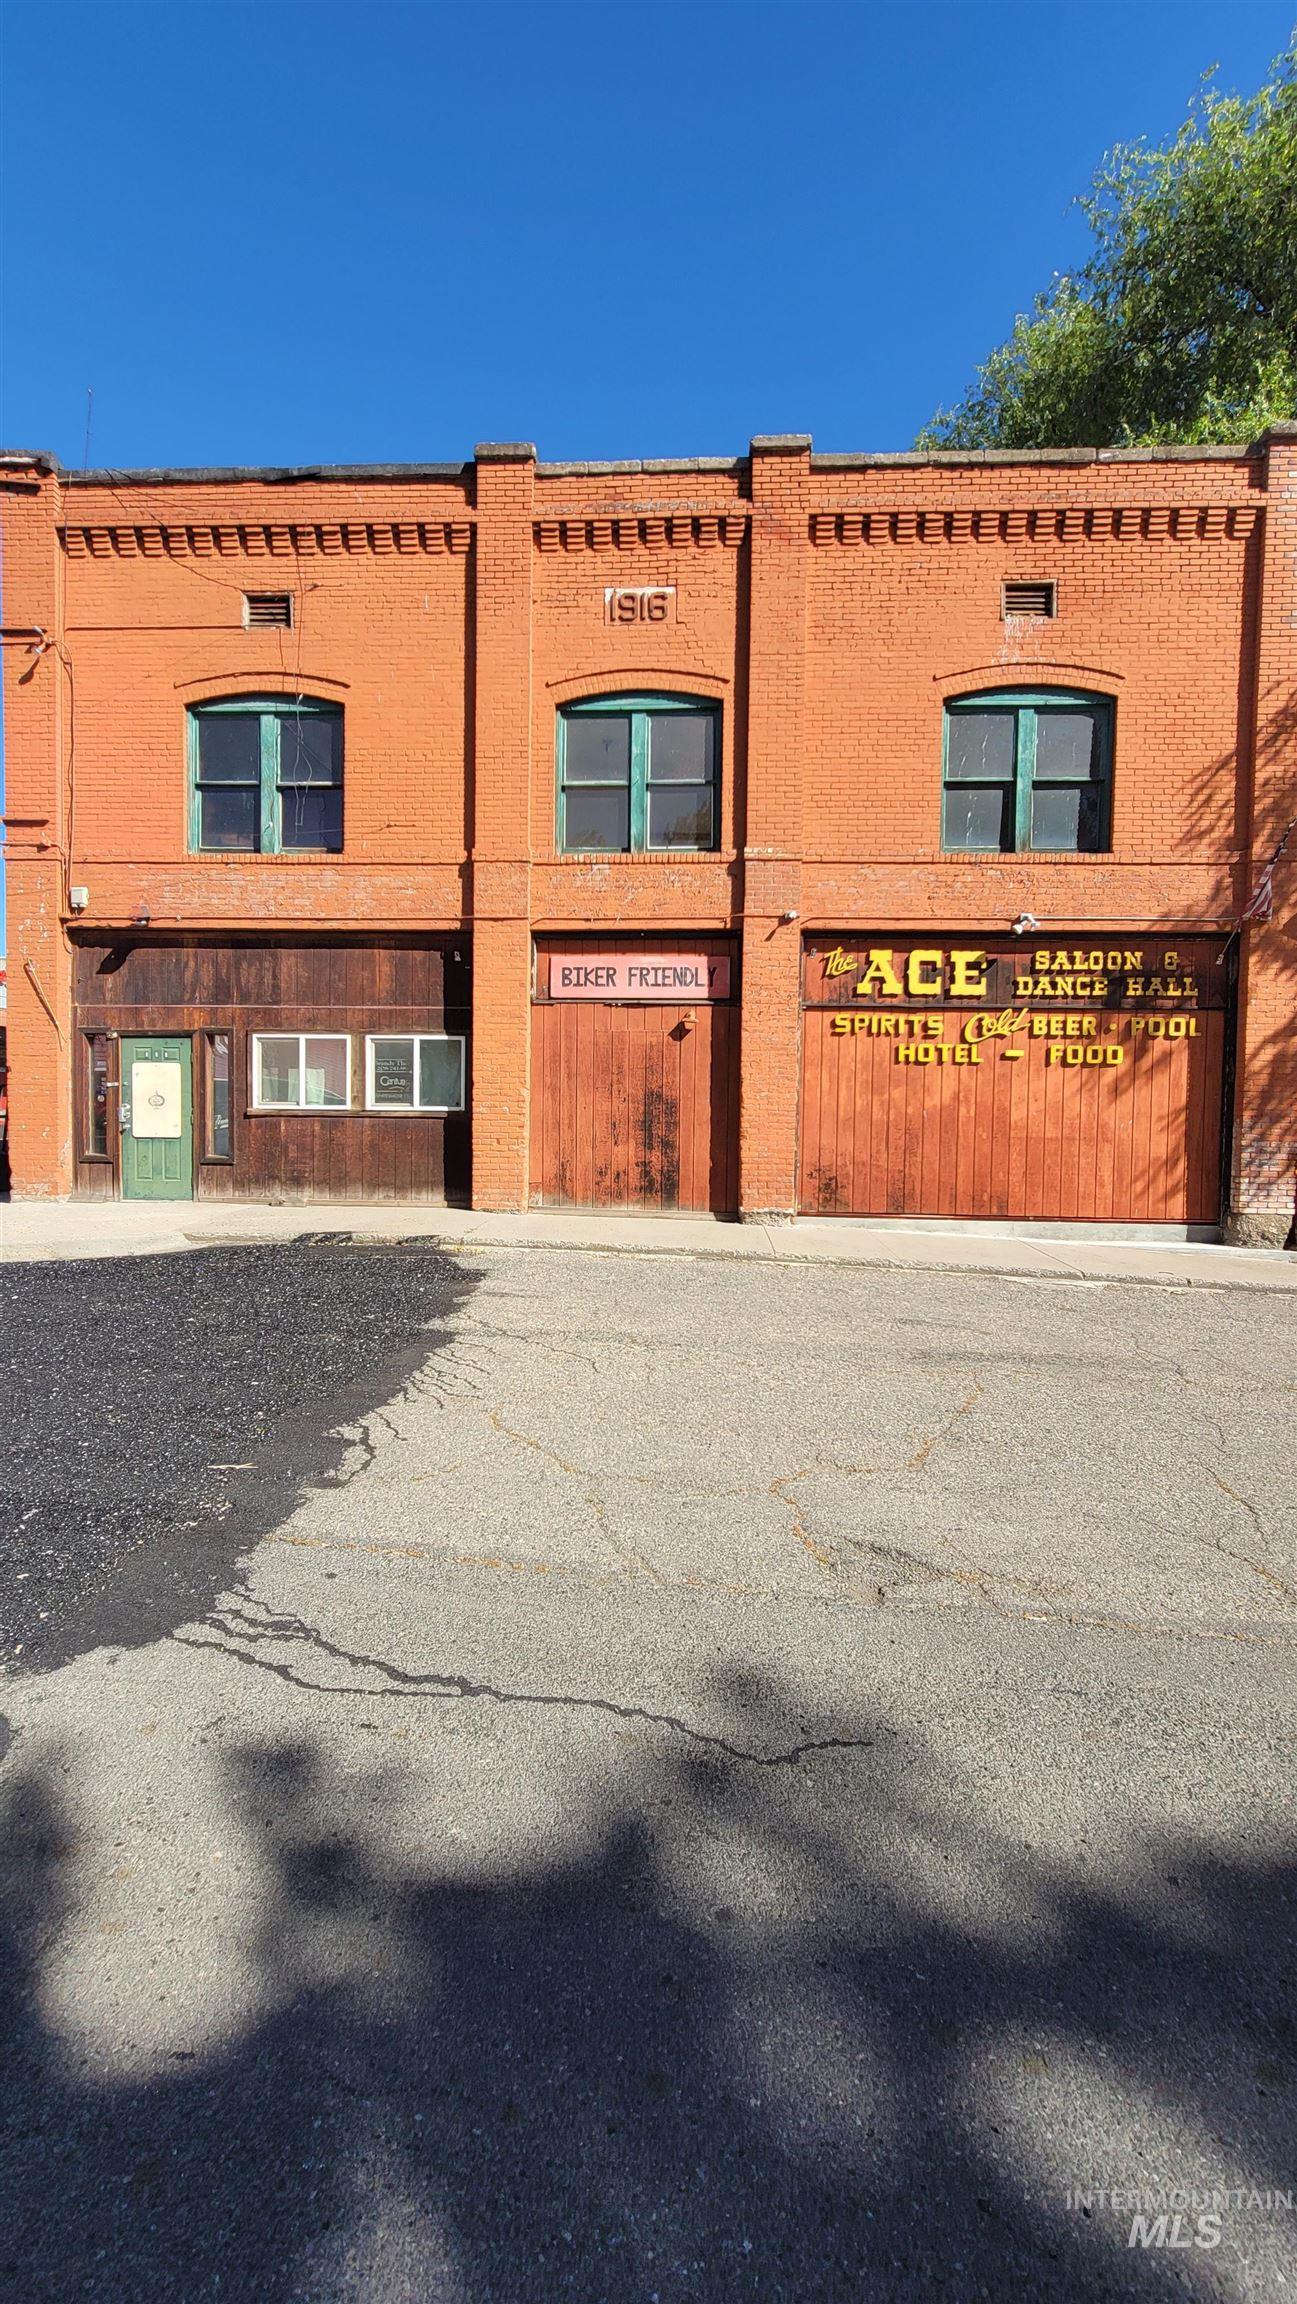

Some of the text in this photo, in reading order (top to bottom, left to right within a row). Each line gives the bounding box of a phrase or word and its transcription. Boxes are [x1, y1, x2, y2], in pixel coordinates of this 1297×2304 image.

[610, 590, 668, 622] 1916
[823, 946, 988, 996] The ACE
[1034, 950, 1179, 971] SALOON &
[561, 966, 718, 988] BIKER FRIENDLY
[1016, 976, 1199, 996] DANCE HALL
[833, 1007, 1202, 1044] SPIRITS Cold BEER POOL
[898, 1043, 983, 1064] HOTEL
[1050, 1044, 1125, 1065] FOOD
